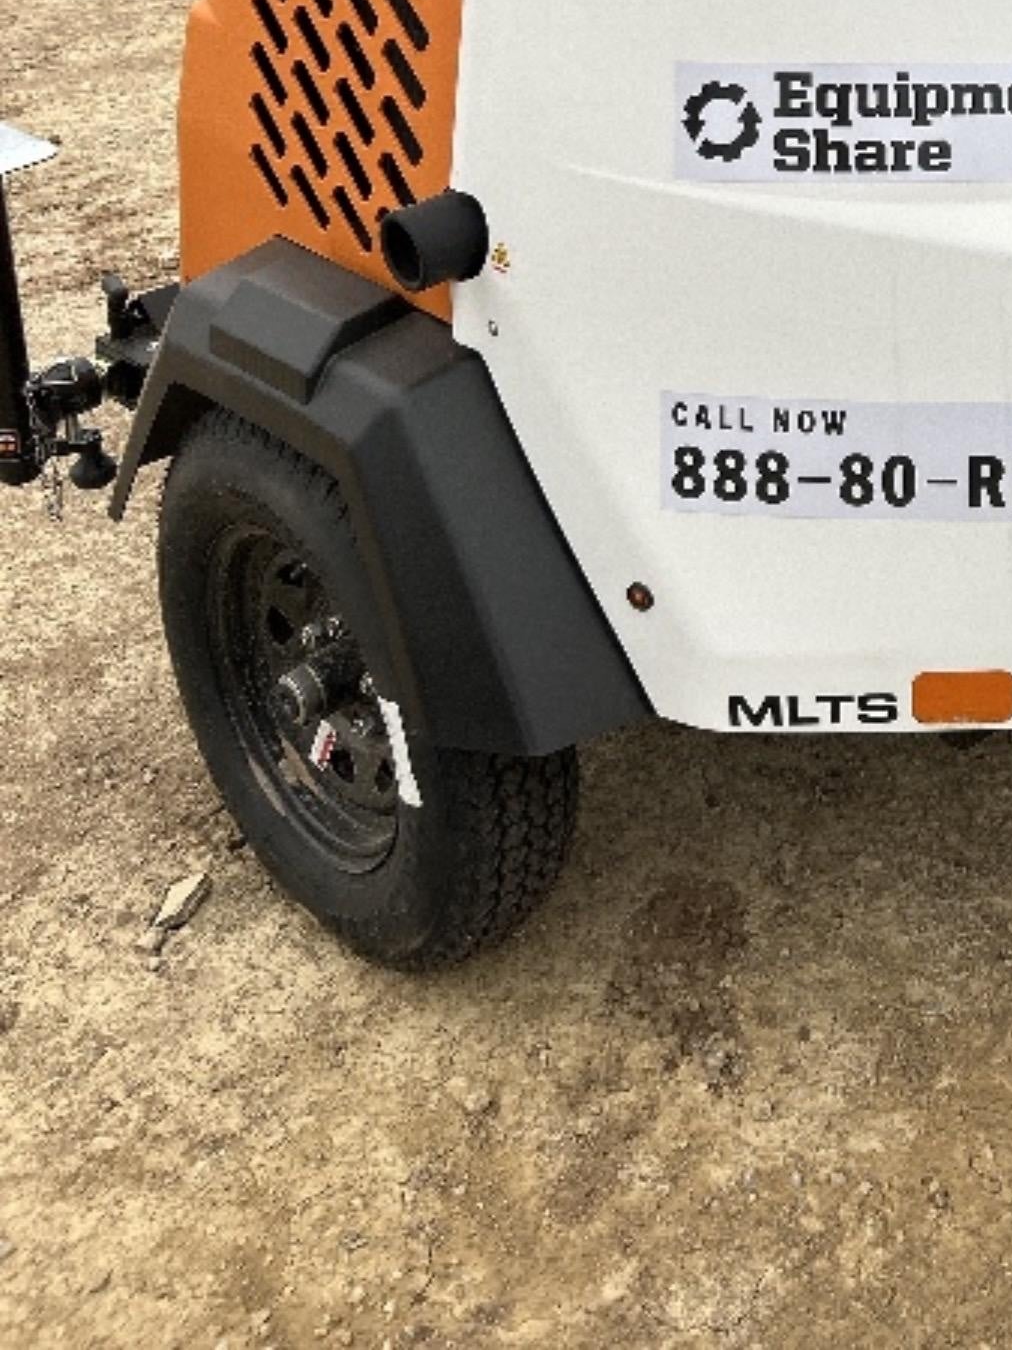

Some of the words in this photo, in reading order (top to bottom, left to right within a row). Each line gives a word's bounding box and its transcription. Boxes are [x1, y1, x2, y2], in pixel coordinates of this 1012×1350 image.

[773, 128, 952, 173] Share
[671, 401, 755, 433] CALL
[772, 407, 847, 436] NOW
[728, 692, 898, 727] MLTS
